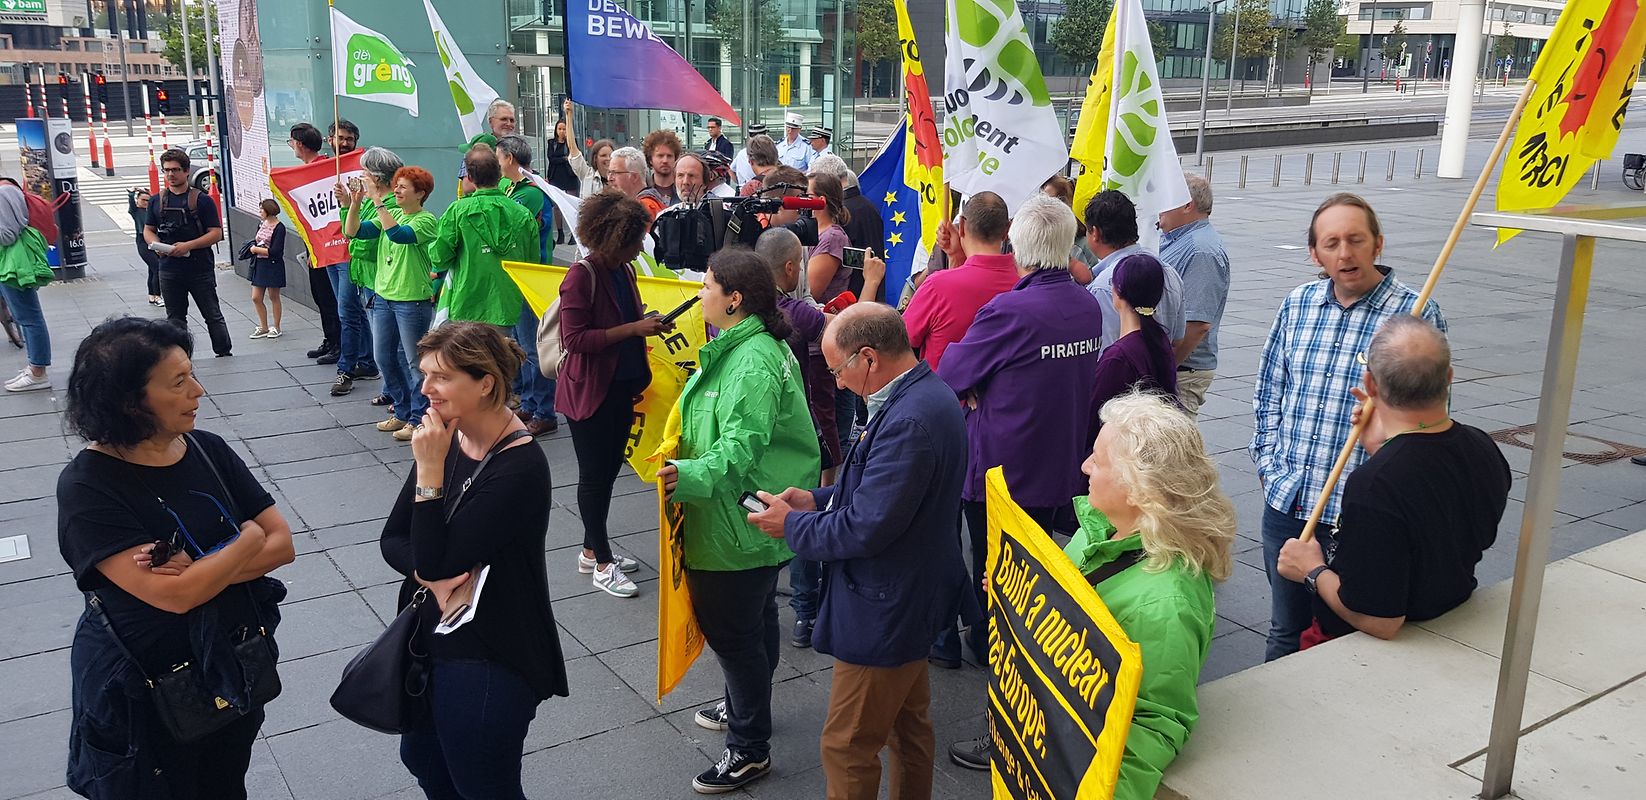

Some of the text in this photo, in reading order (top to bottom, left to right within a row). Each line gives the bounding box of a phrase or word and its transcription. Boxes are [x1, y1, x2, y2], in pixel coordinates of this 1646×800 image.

[18, 0, 42, 9] bam
[995, 540, 1109, 710] Build a nuclear
